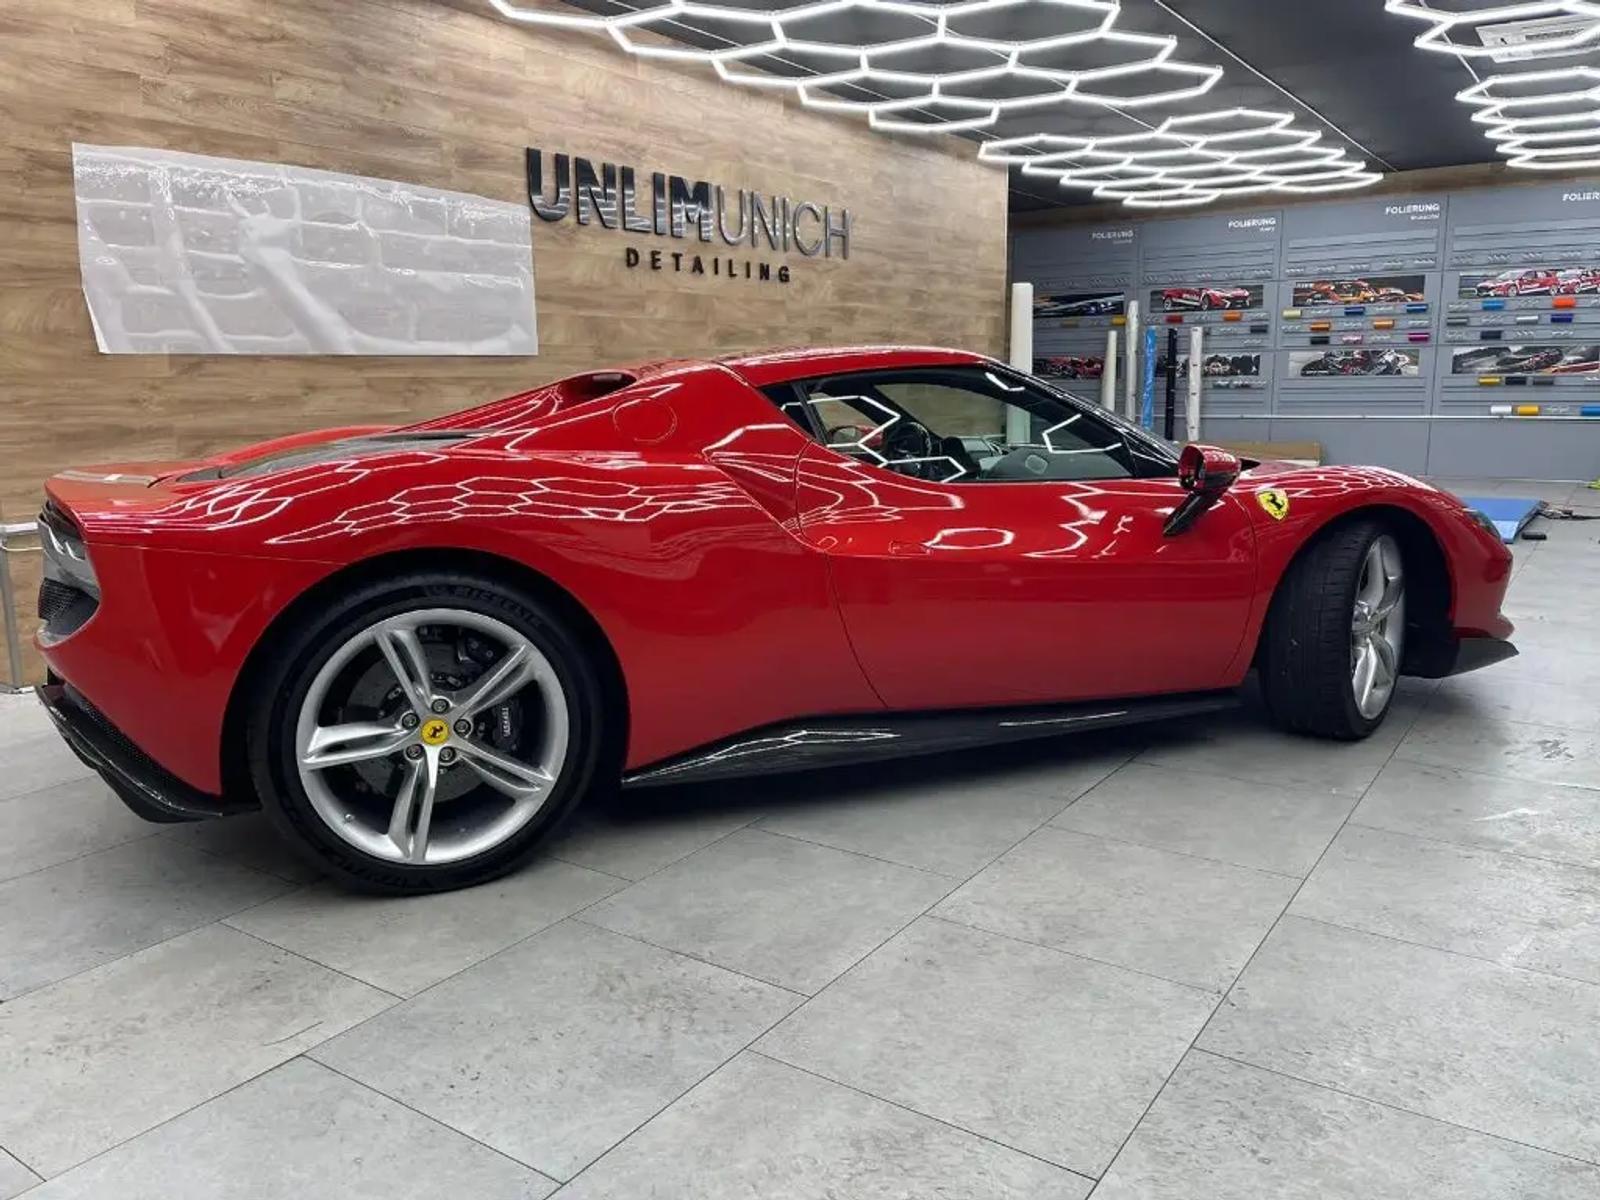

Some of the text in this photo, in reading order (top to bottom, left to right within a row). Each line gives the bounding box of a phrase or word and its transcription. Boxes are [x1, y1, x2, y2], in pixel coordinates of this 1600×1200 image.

[1385, 203, 1440, 215] FOLIERUNG
[1228, 217, 1276, 228] FOLIERUNG
[626, 247, 790, 283] DETAILING
